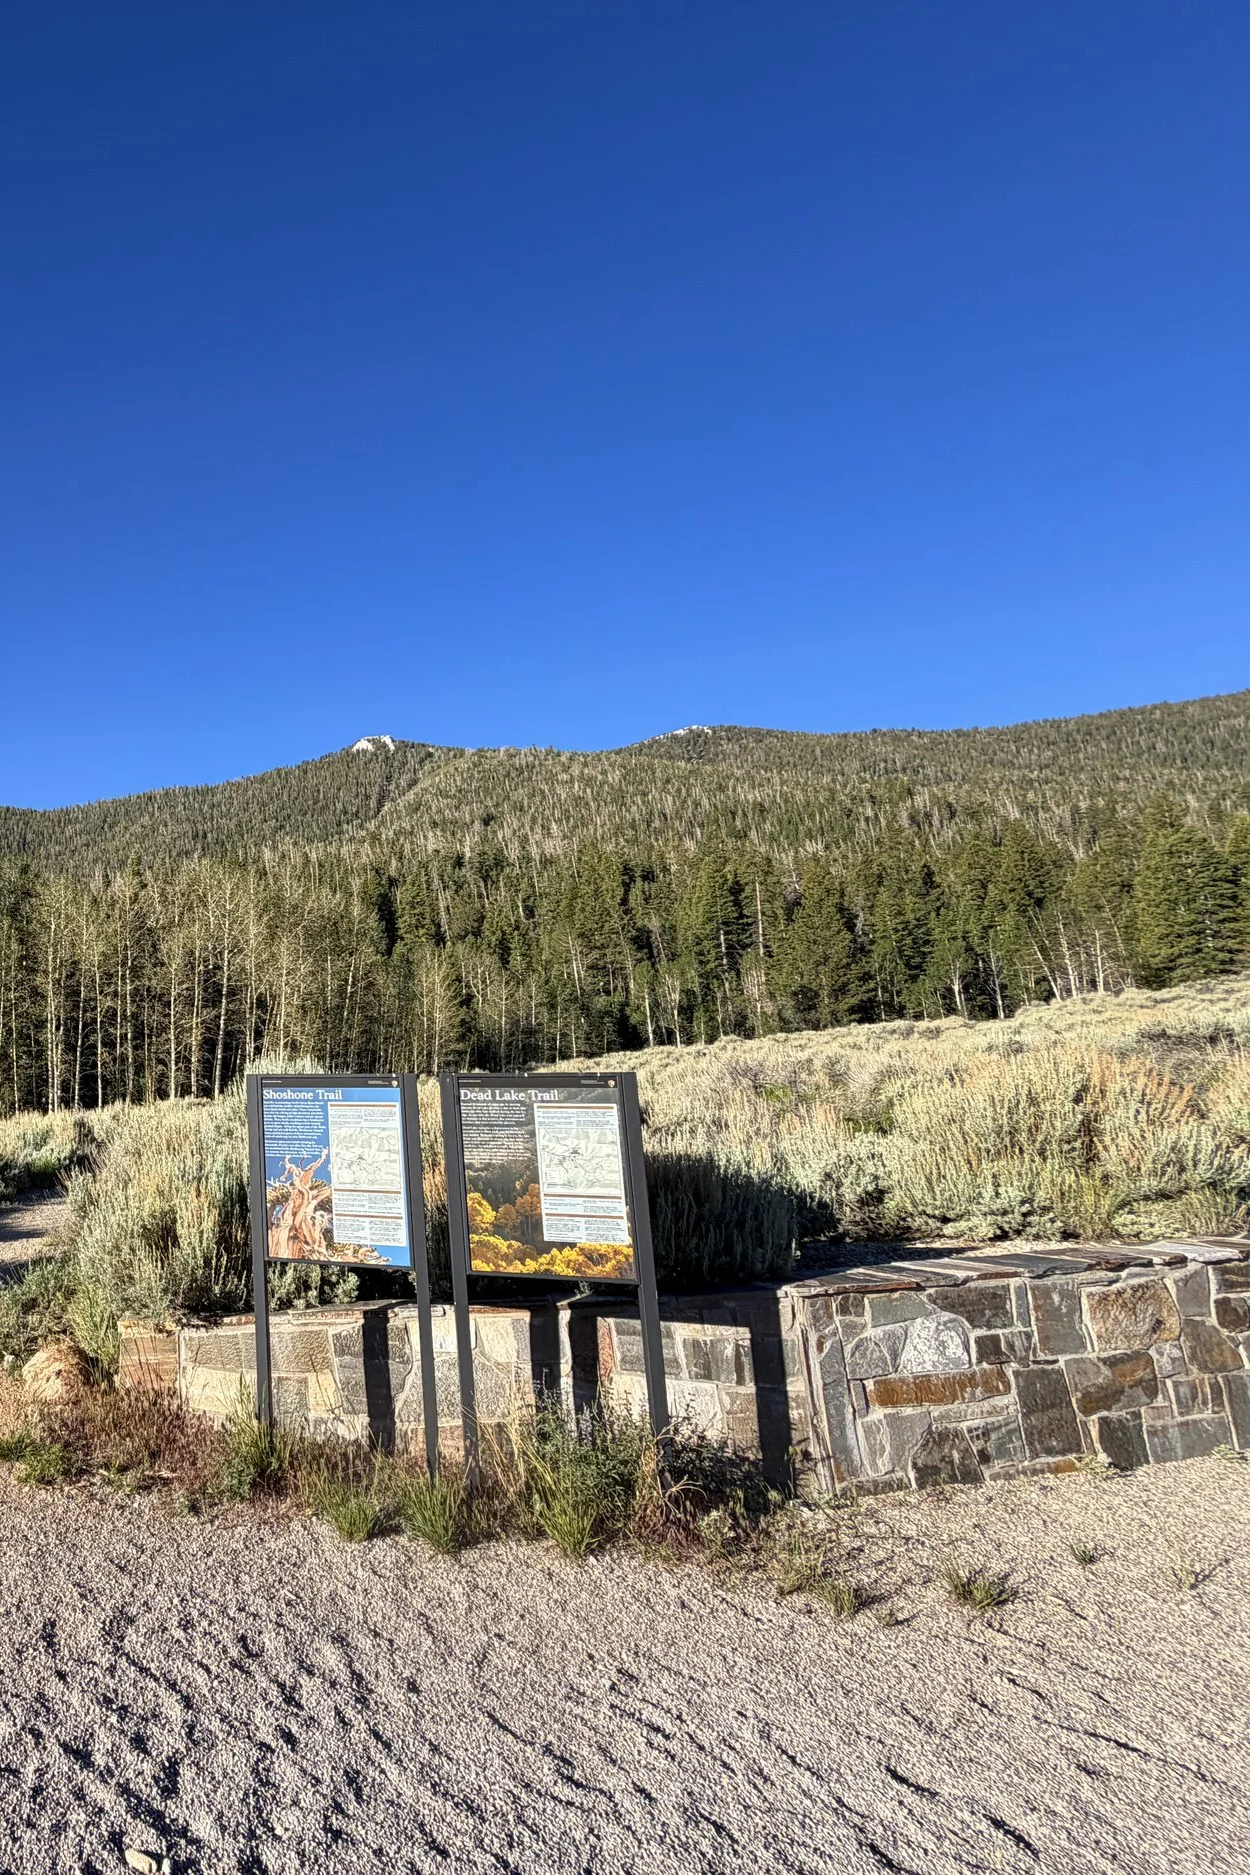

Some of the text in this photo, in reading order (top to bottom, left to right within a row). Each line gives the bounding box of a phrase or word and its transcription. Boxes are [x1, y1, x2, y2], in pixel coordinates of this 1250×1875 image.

[263, 1089, 343, 1100] Shoshone Trail
[460, 1089, 559, 1101] Dead Lake Trail
